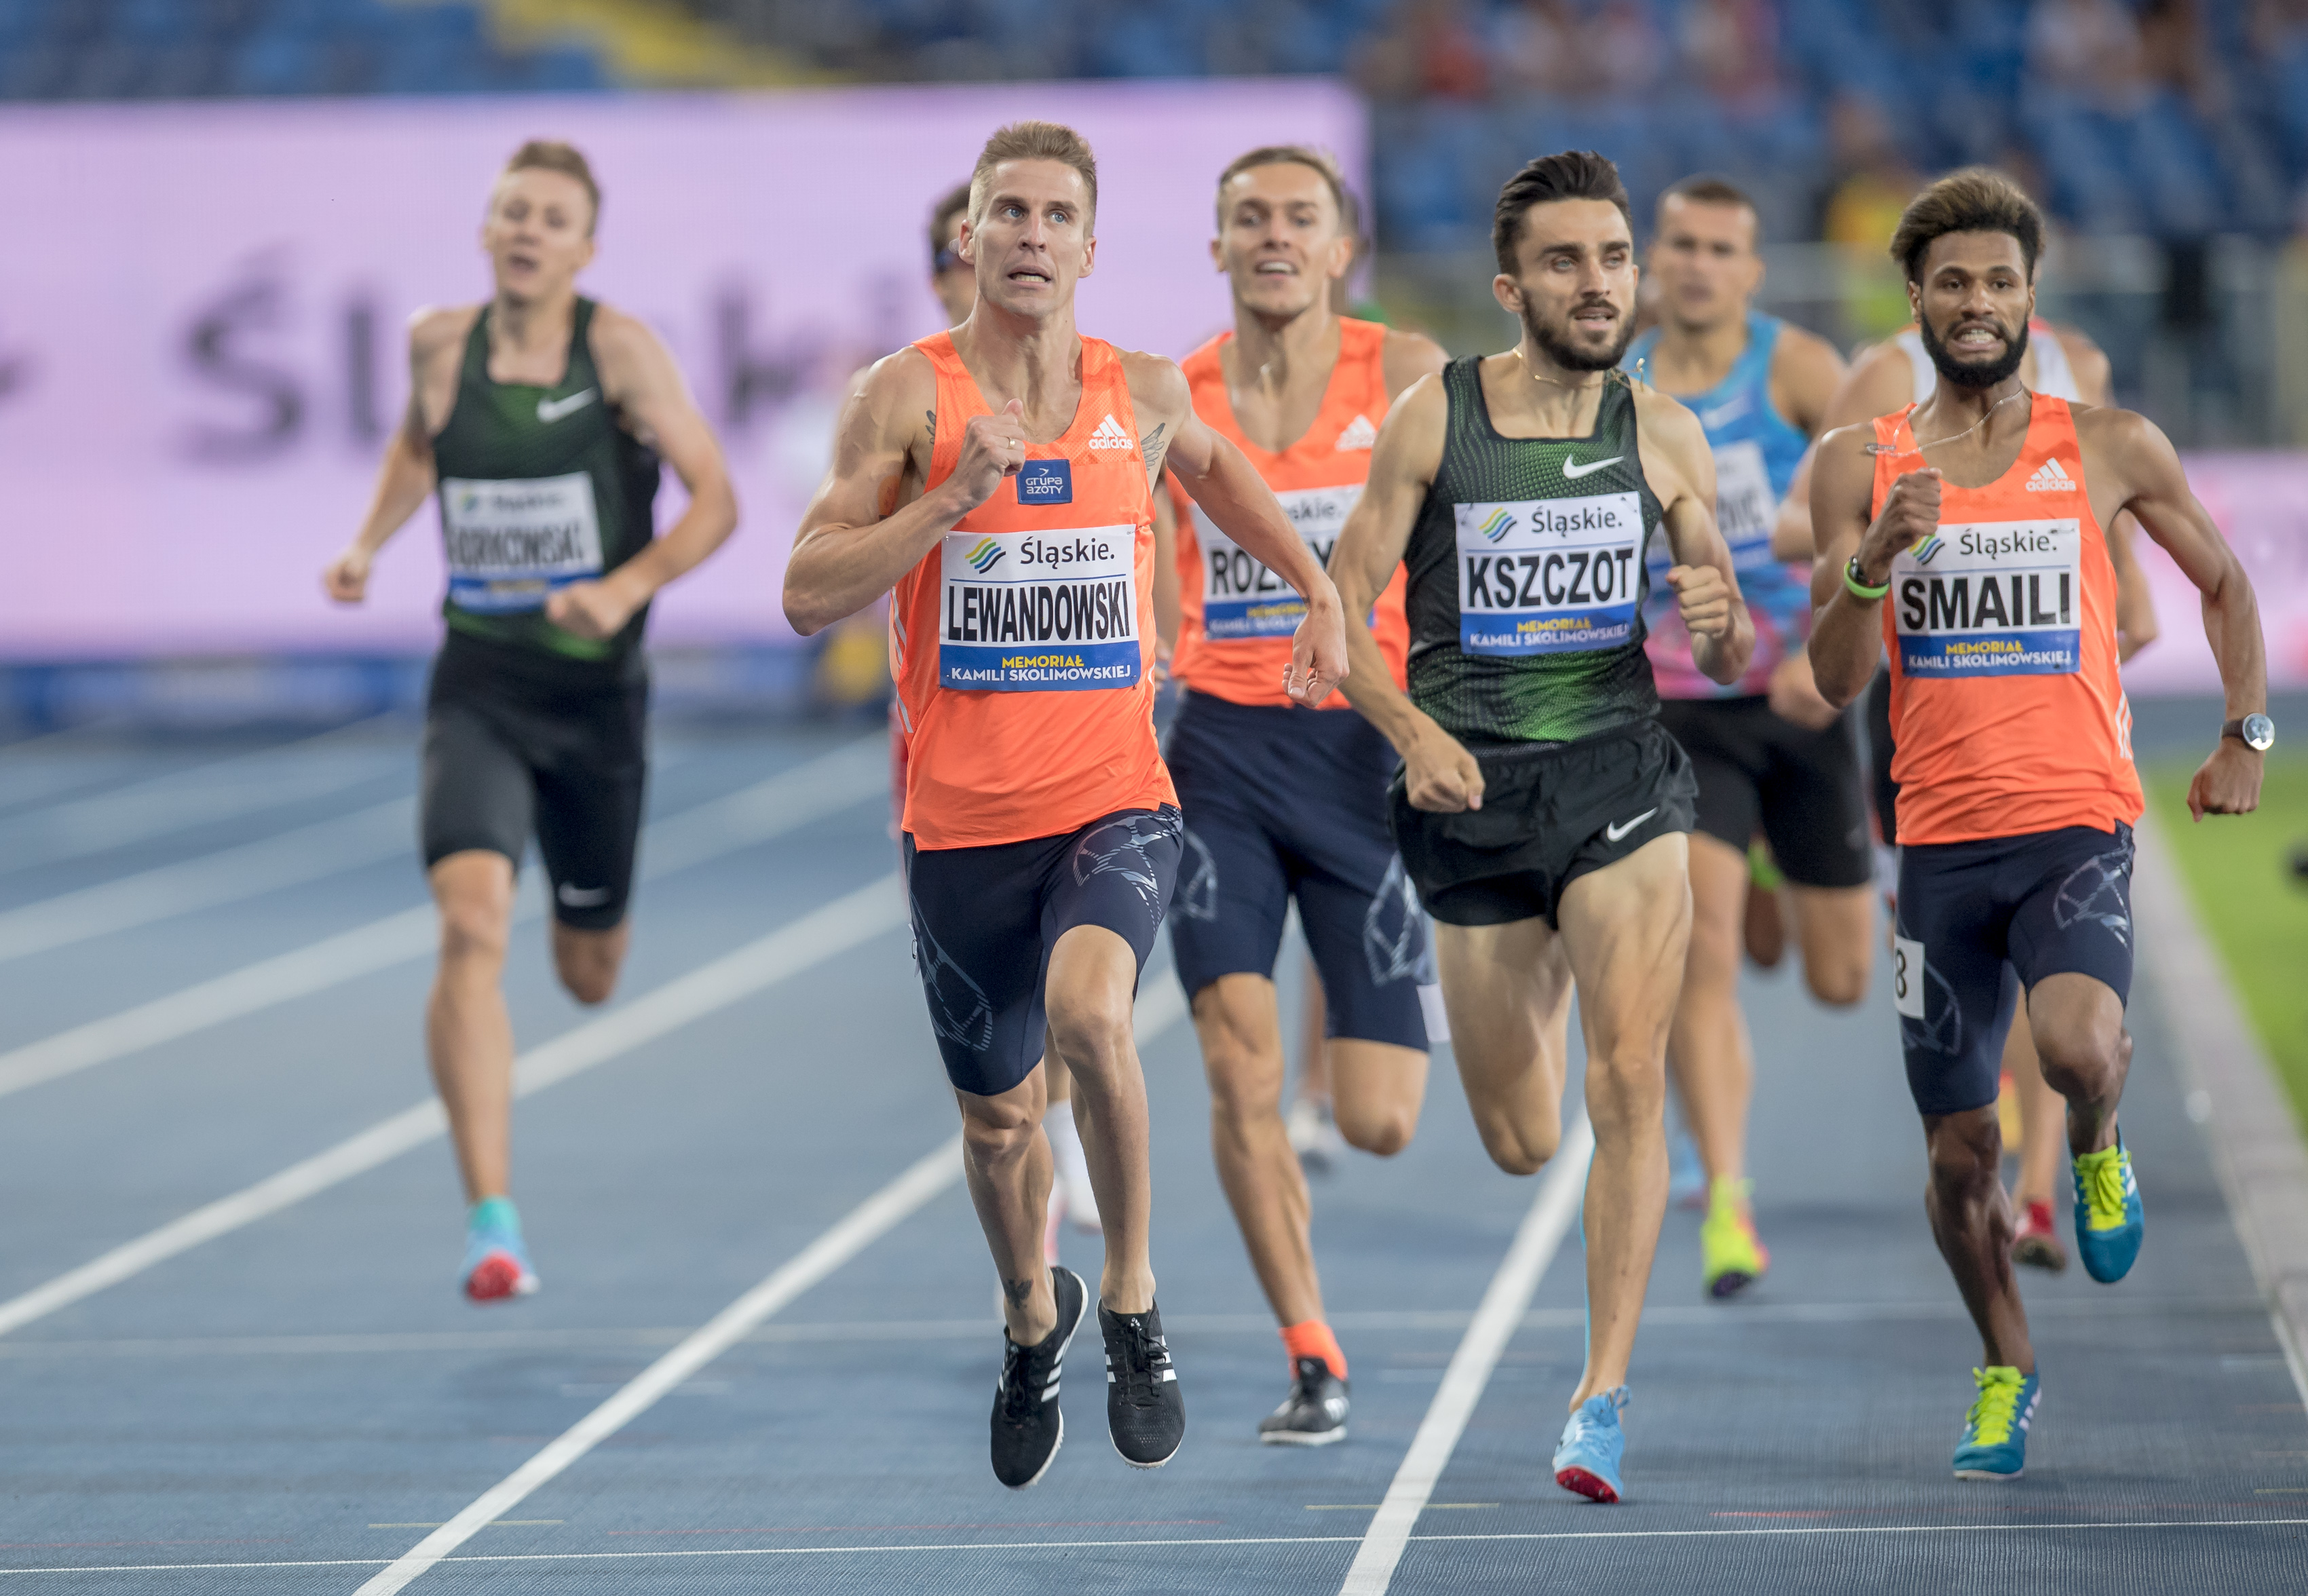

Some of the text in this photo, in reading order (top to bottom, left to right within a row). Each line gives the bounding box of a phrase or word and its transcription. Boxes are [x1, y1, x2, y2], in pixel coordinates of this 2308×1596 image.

[1089, 436, 1134, 450] adidas
[2026, 478, 2077, 492] adidas
[1531, 505, 1623, 537] Śląskie.
[1020, 536, 1115, 569] Śląskie.
[1959, 528, 2058, 560] Śląskie.
[1466, 547, 1634, 608] KSZCZOT
[1902, 572, 2071, 630] SMAILI
[948, 581, 1131, 643] LEWANDOWSKI
[1469, 624, 1628, 647] KAMILI SKOLIMOWSKIEJ
[1517, 618, 1592, 633] MEMORIAŁ
[1945, 640, 2024, 656] MEMORIAŁ
[1002, 655, 1084, 668] MEMORIAŁ
[1908, 650, 2070, 669] KAMILI SKOLIMOWSKIEJ
[951, 665, 1131, 681] KAMILI SKOLIMOWSKIEJ
